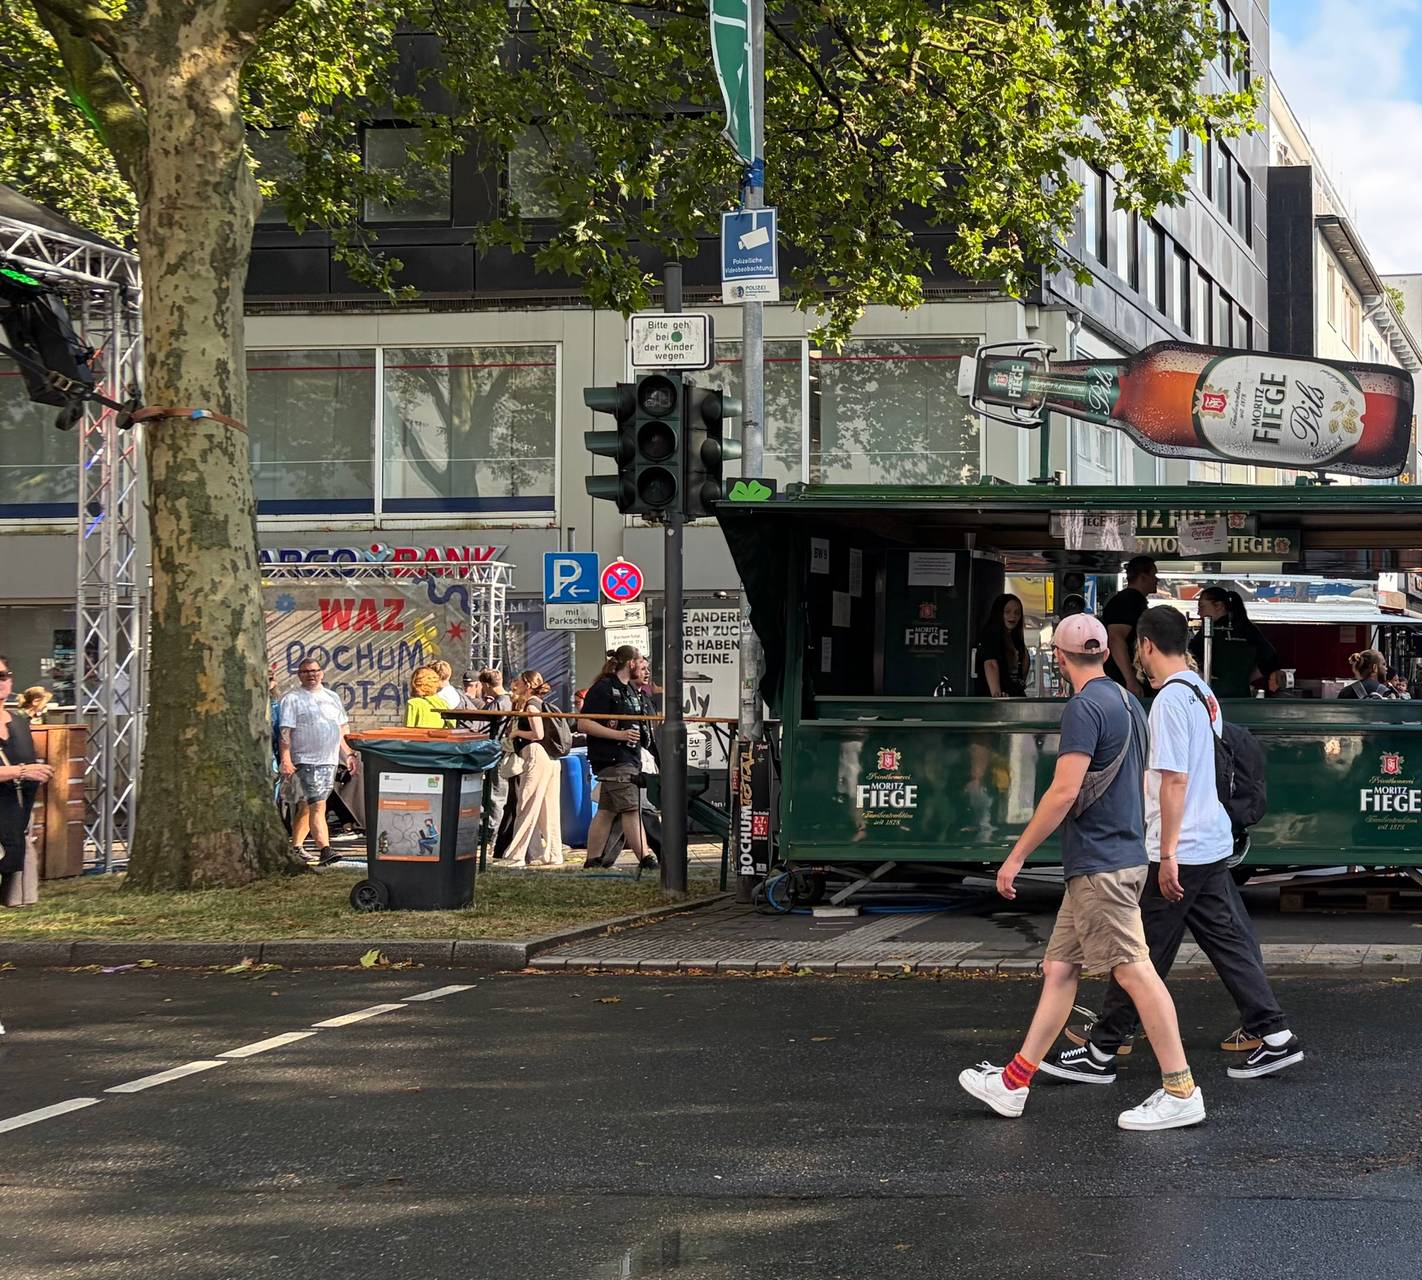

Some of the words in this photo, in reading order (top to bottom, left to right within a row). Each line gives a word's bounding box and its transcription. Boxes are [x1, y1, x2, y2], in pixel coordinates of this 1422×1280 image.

[648, 320, 668, 329] Bitte
[656, 333, 669, 341] bei
[664, 343, 694, 351] Kinder
[1008, 365, 1025, 398] FIEGE
[1088, 367, 1113, 416] Pils
[1252, 387, 1265, 428] MORITZ
[1252, 372, 1287, 444] FIEGE
[1290, 380, 1325, 447] Pils
[318, 598, 406, 631] WAZ
[565, 608, 579, 616] mit
[683, 625, 709, 636] BEN
[905, 629, 949, 646] FIEGE
[697, 639, 740, 650] HABEN
[286, 638, 424, 677] BOCHUM
[684, 653, 734, 664] OTEINE.
[871, 782, 904, 790] MORITZ
[1374, 786, 1408, 794] MORITZ
[856, 785, 918, 808] FIEGE
[1360, 788, 1422, 812] FIEGE
[740, 806, 755, 875] BOCHUM
